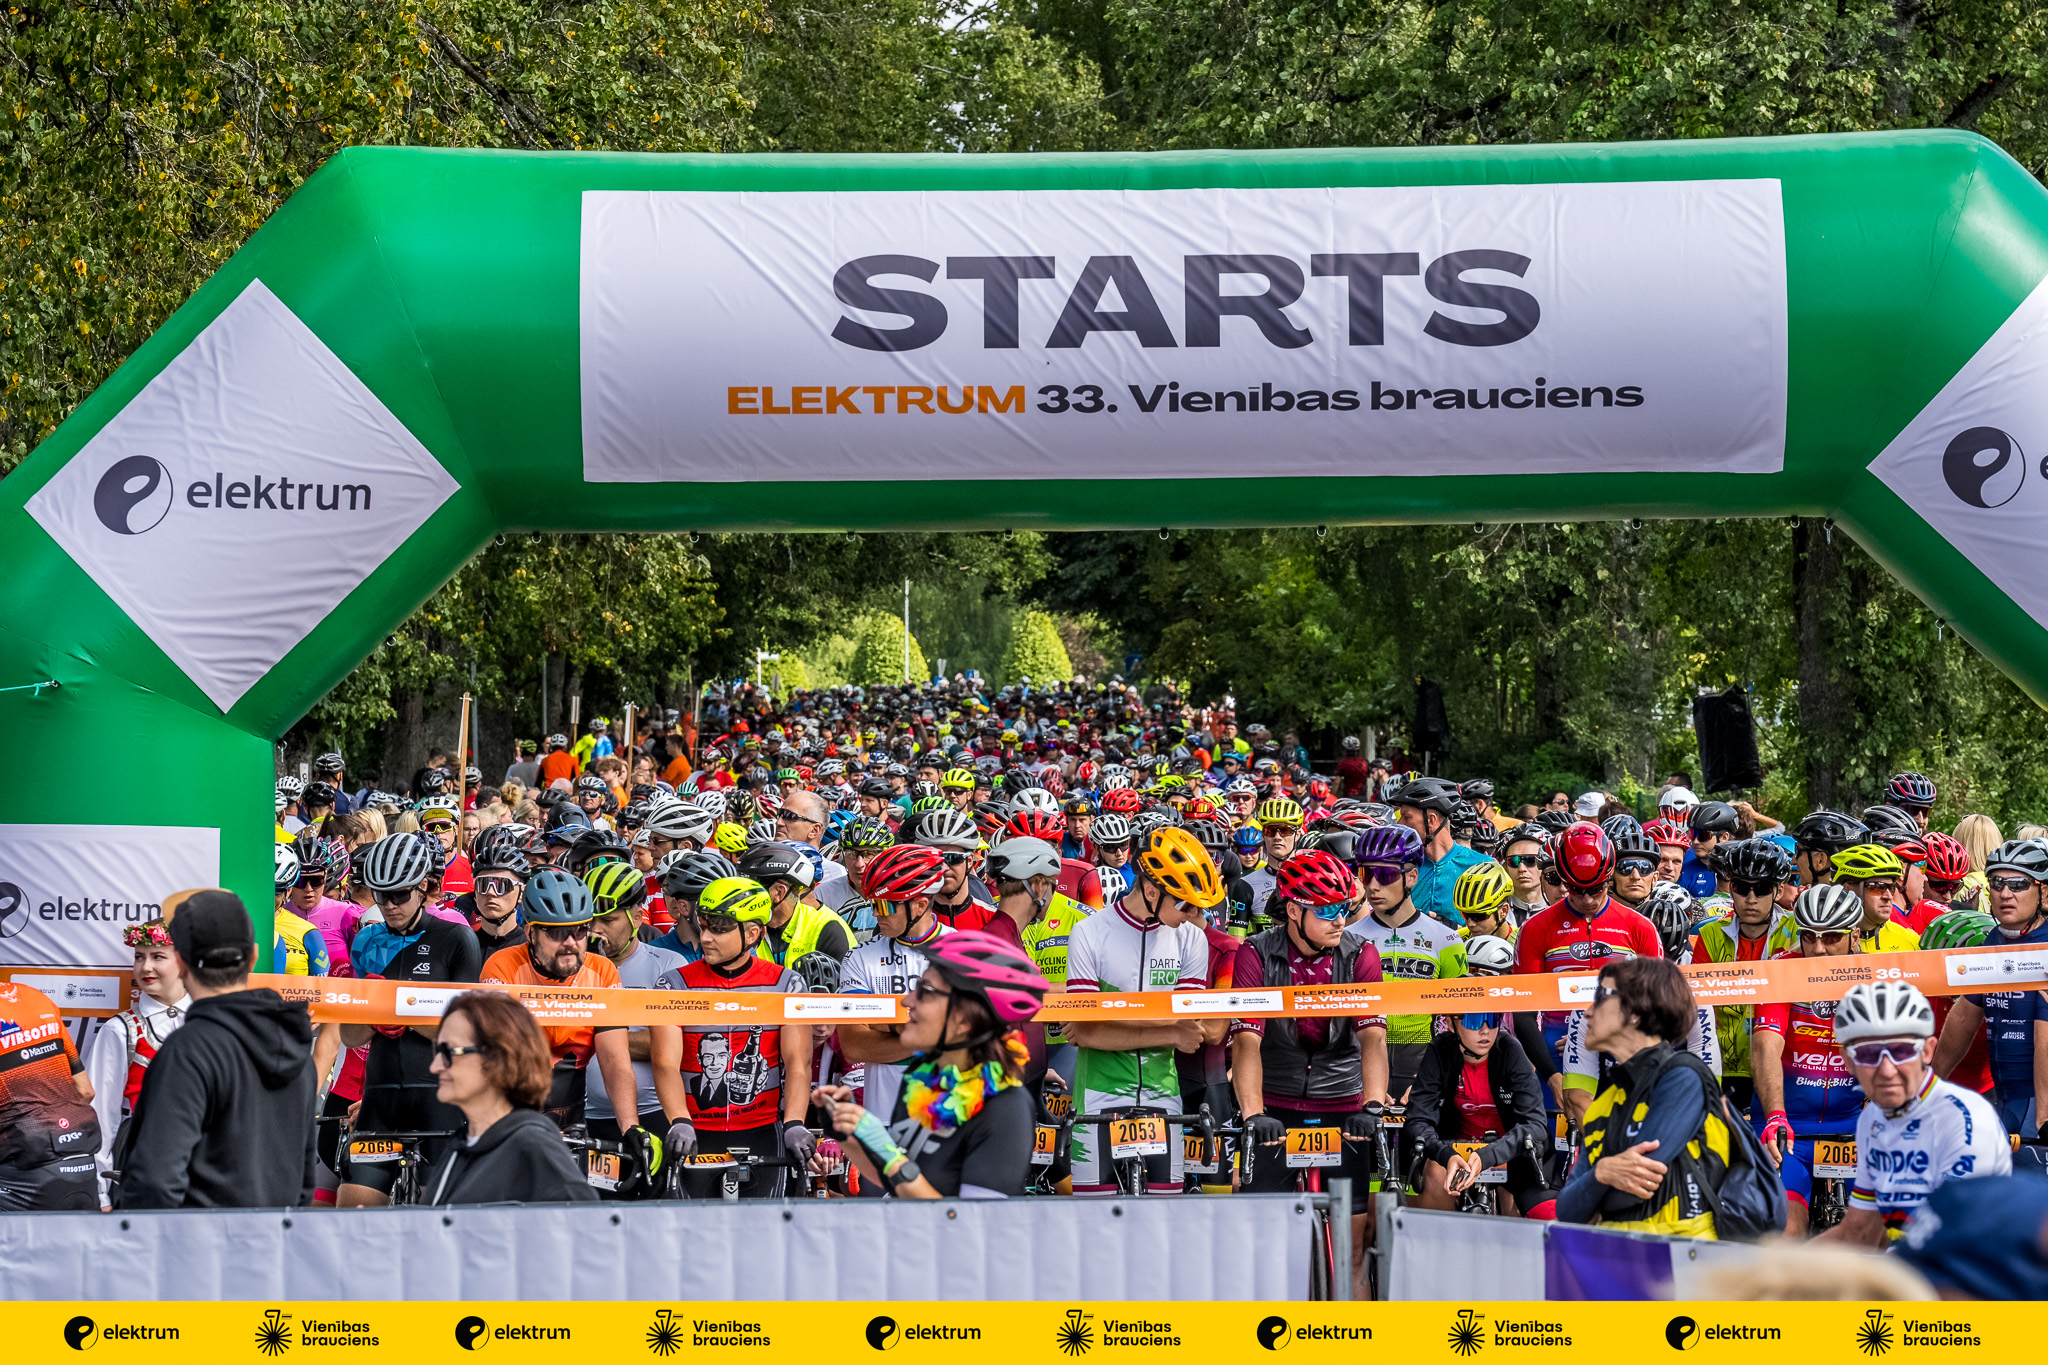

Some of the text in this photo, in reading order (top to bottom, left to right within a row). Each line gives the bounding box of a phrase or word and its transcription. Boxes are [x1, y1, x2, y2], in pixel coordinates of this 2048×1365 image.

[831, 249, 1541, 352] STARTS
[727, 377, 1646, 415] ELEKTRUM 33. Vienības brauciens
[187, 472, 372, 511] elektrum
[38, 895, 162, 922] elektrum
[1036, 956, 1067, 966] CYCLING
[1150, 958, 1175, 969] DART
[1041, 965, 1066, 975] ROJECT
[1829, 967, 1871, 975] TAUTAS
[1875, 967, 1901, 980] 36
[1807, 974, 1872, 983] BRAUCIENS
[281, 988, 322, 996] TAUTAS
[520, 992, 593, 1000] ELEKTRUM
[1294, 988, 1367, 996] ELEKTRUM
[1488, 987, 1514, 997] 36
[1691, 988, 1757, 998] rauciens
[282, 995, 321, 1003] UCIENS
[325, 992, 351, 1005] 36
[713, 1002, 741, 1011] 36
[1101, 1000, 1128, 1008] 36
[1294, 1002, 1369, 1010] brauciens
[530, 1010, 593, 1018] rauciens
[28, 1043, 58, 1057] Marmot
[1792, 1062, 1827, 1071] CYCLING
[730, 1108, 741, 1117] THE
[742, 1103, 757, 1114] NIGHT
[1119, 1122, 1157, 1143] 2053
[358, 1140, 394, 1154] 2069
[1298, 1132, 1330, 1152] 2191
[1822, 1144, 1857, 1164] 2065
[697, 1155, 726, 1164] 059
